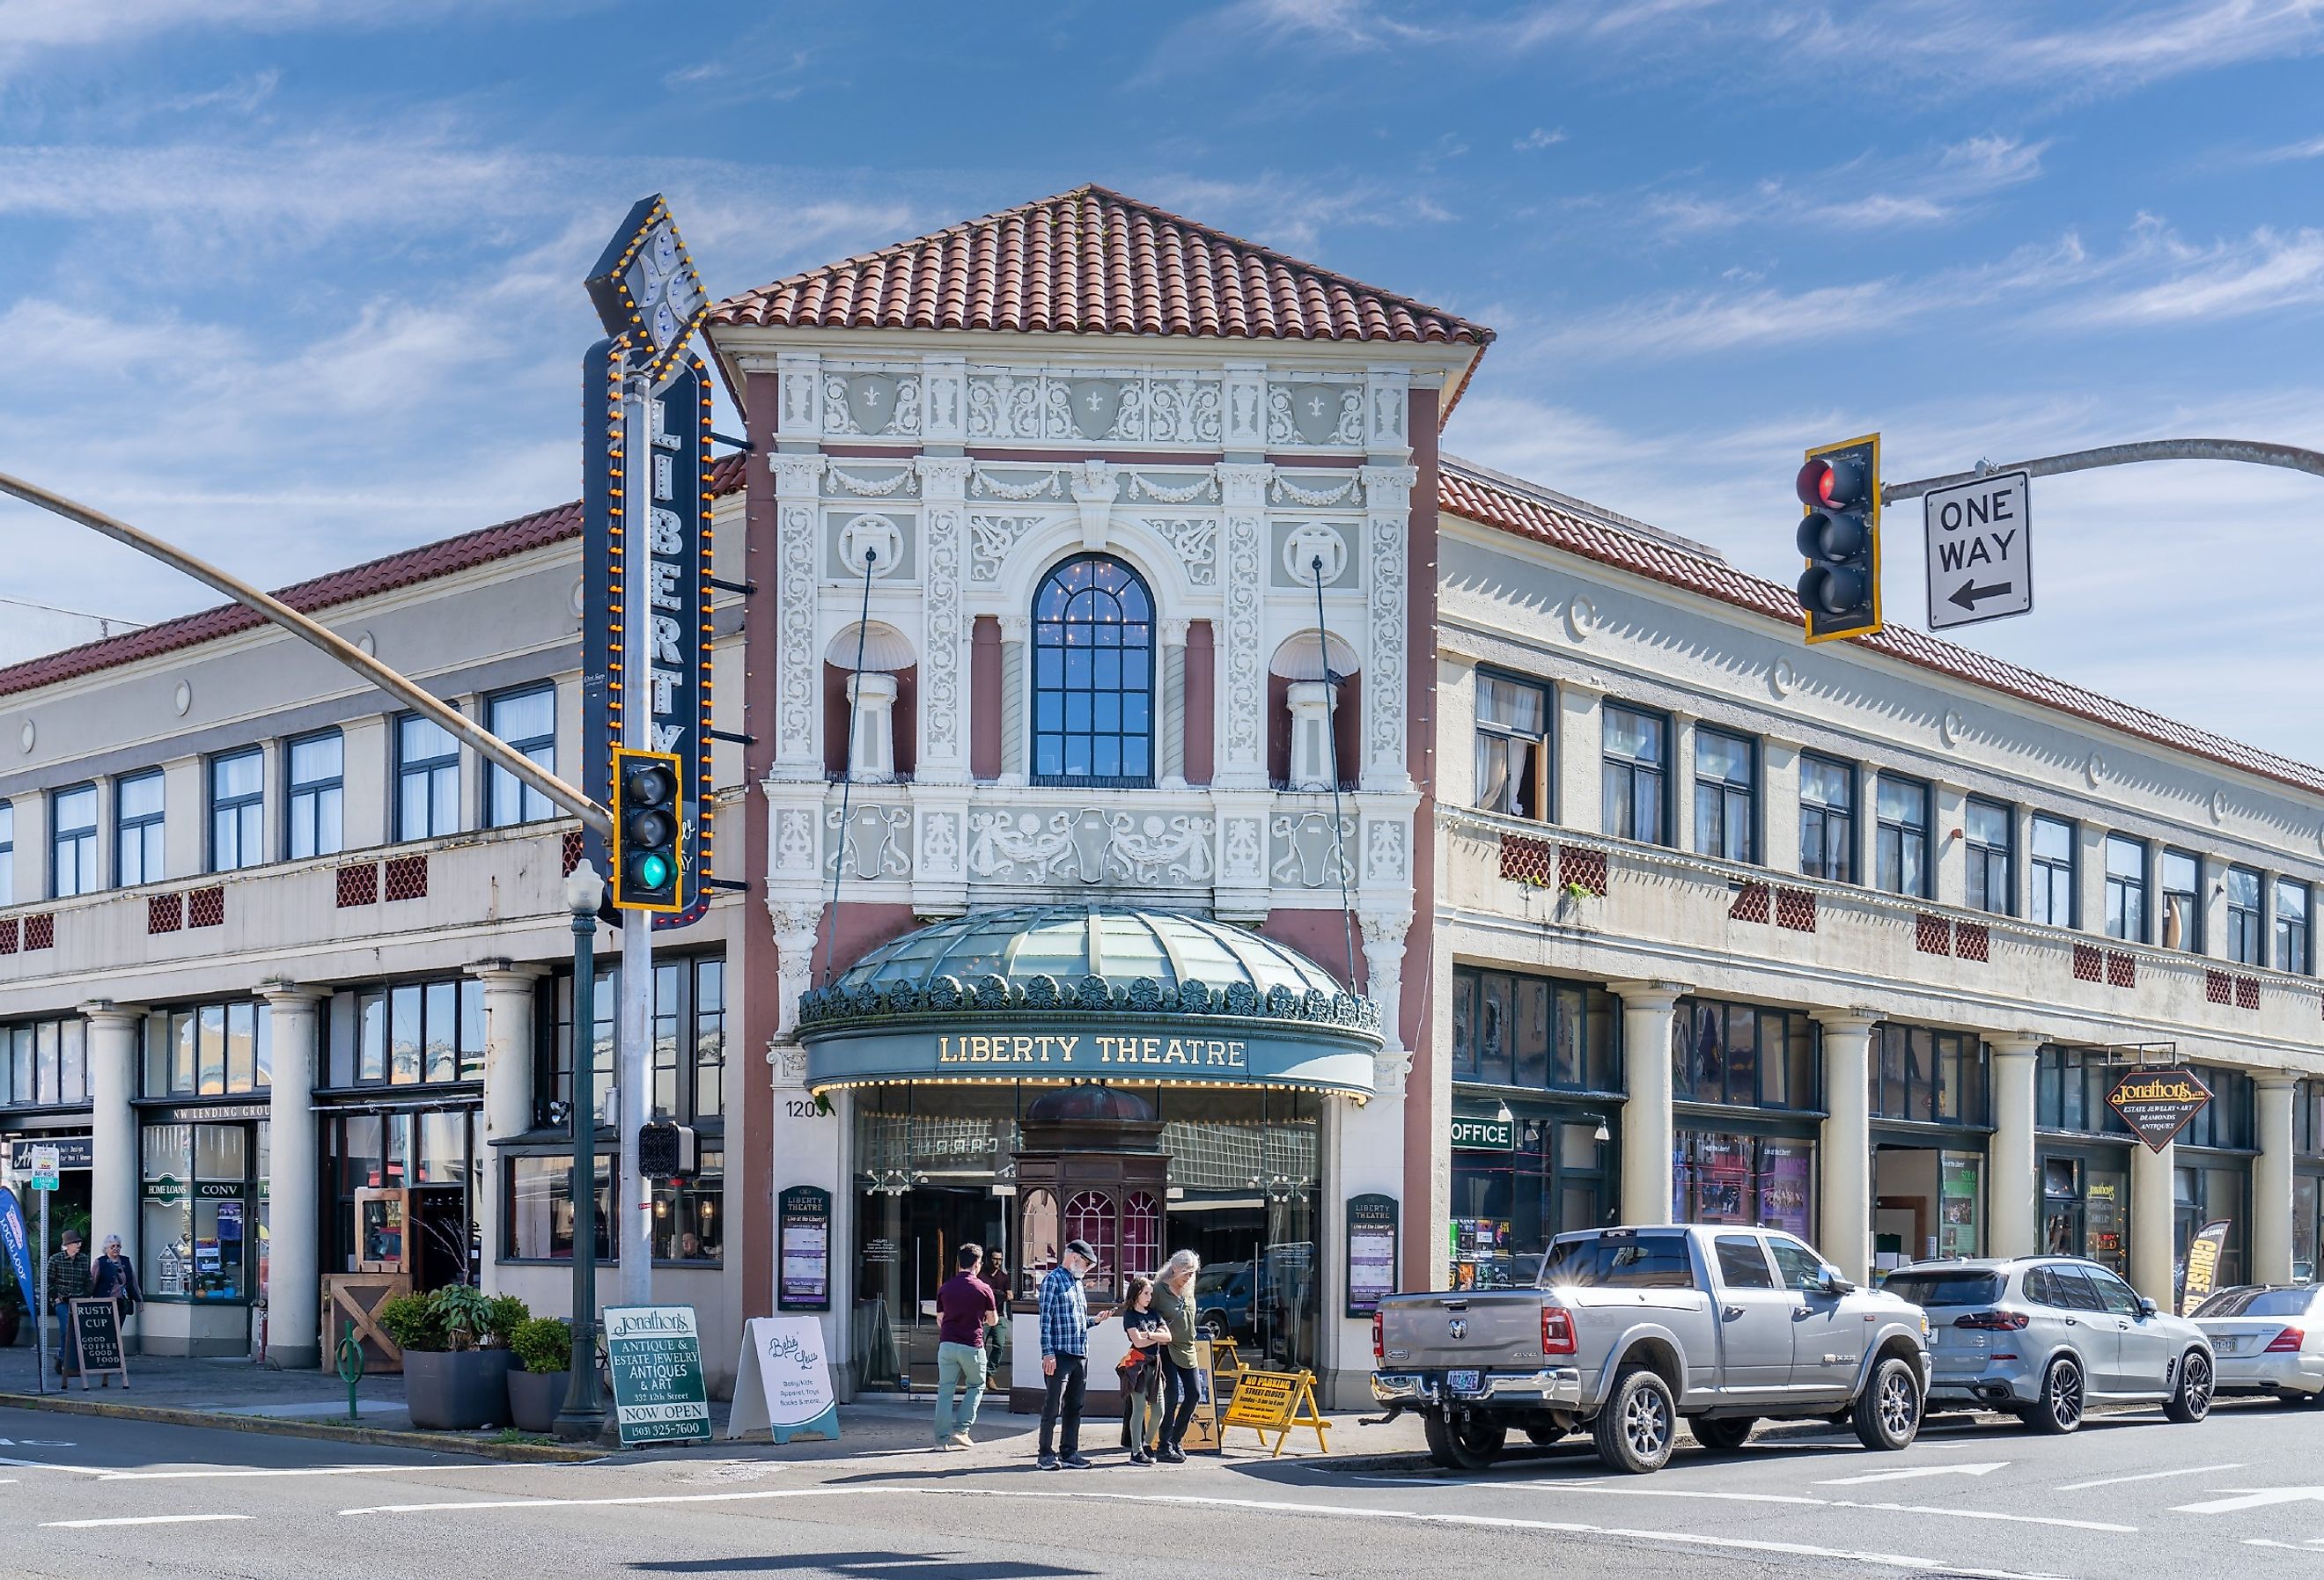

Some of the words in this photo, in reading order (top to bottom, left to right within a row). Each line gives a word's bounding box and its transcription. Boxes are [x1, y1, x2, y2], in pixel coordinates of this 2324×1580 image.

[1940, 489, 2014, 532] ONE
[1938, 528, 2017, 573] WAY
[650, 399, 685, 754] LIBERTY
[939, 1036, 1081, 1063] LIBERTY
[1095, 1036, 1246, 1067] THEATRE
[2112, 1078, 2191, 1106] Jonathon's
[173, 1109, 188, 1120] NW
[193, 1106, 238, 1119] LENDING
[242, 1106, 270, 1116] GROU
[1452, 1122, 1508, 1143] OFFICE
[148, 1185, 166, 1194] HOME
[166, 1185, 187, 1194] LOANS
[202, 1185, 238, 1195] CONV
[0, 1218, 16, 1253] LOCAL
[2197, 1229, 2225, 1238] WELCOME
[12, 1253, 26, 1281] LOOP
[2186, 1239, 2217, 1293] CRUISE
[77, 1306, 112, 1316] RUSTY
[85, 1319, 107, 1328] CUP
[614, 1311, 689, 1337] Jonathon's
[621, 1340, 675, 1353] ANTIQUE
[678, 1339, 688, 1350] &
[614, 1353, 651, 1366] ESTATE
[653, 1352, 698, 1365] JEWELRY
[629, 1364, 688, 1379] ANTIQUES
[641, 1381, 649, 1391] &
[651, 1378, 673, 1391] ART
[1245, 1375, 1257, 1385] NO
[1257, 1376, 1291, 1390] PARKING
[634, 1393, 647, 1402] 332
[650, 1393, 665, 1401] 12th
[666, 1393, 688, 1401] Street
[1245, 1387, 1265, 1397] STREET
[1264, 1390, 1286, 1399] CLOSED
[625, 1407, 659, 1422] NOW
[665, 1404, 702, 1419] OPEN
[632, 1426, 651, 1437] (503)
[652, 1422, 700, 1437] 325-7600
